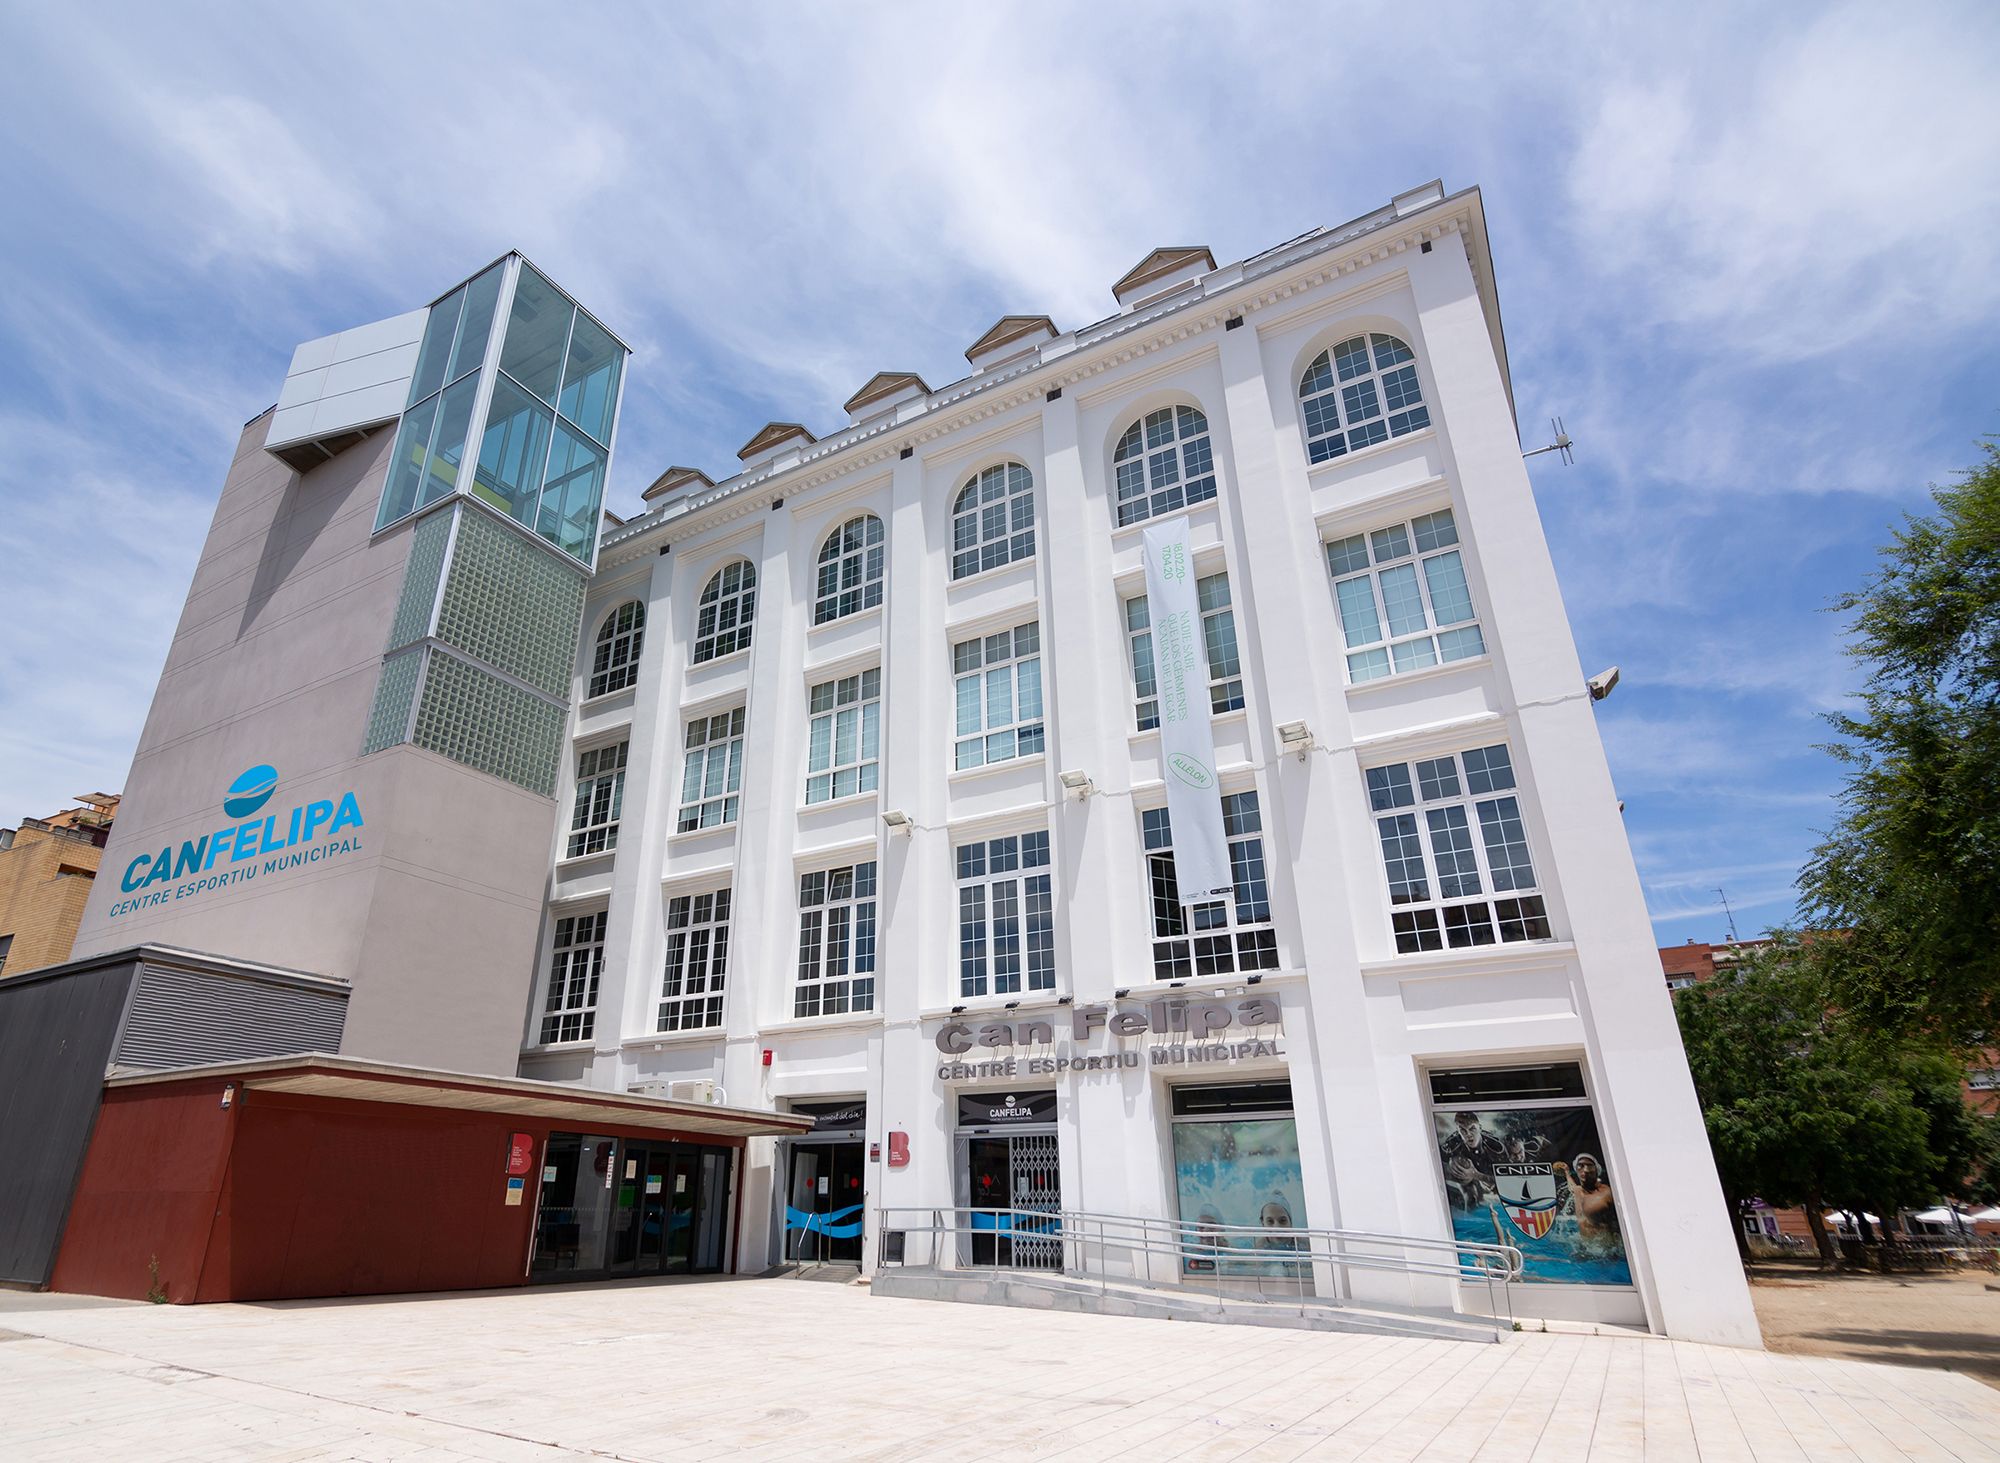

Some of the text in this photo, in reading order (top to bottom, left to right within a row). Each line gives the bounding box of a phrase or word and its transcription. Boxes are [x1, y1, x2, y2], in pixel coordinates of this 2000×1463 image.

[1158, 619, 1169, 661] ACABAN
[1168, 613, 1178, 637] QUE
[1180, 610, 1195, 672] NADIE SABE
[1170, 638, 1180, 660] LOS
[1162, 664, 1171, 678] DE
[1172, 757, 1207, 784] ALLELON
[120, 791, 364, 893] CANFELIPA
[110, 837, 362, 917] CENTRE ESPORTIU MUNICIPAL
[935, 1000, 1281, 1055] Can Felipa
[938, 1041, 1286, 1081] CENTRE ESPORTIU MUNICIPAL
[989, 1107, 1033, 1118] CANFELIPA
[1496, 1165, 1550, 1175] CNPN
